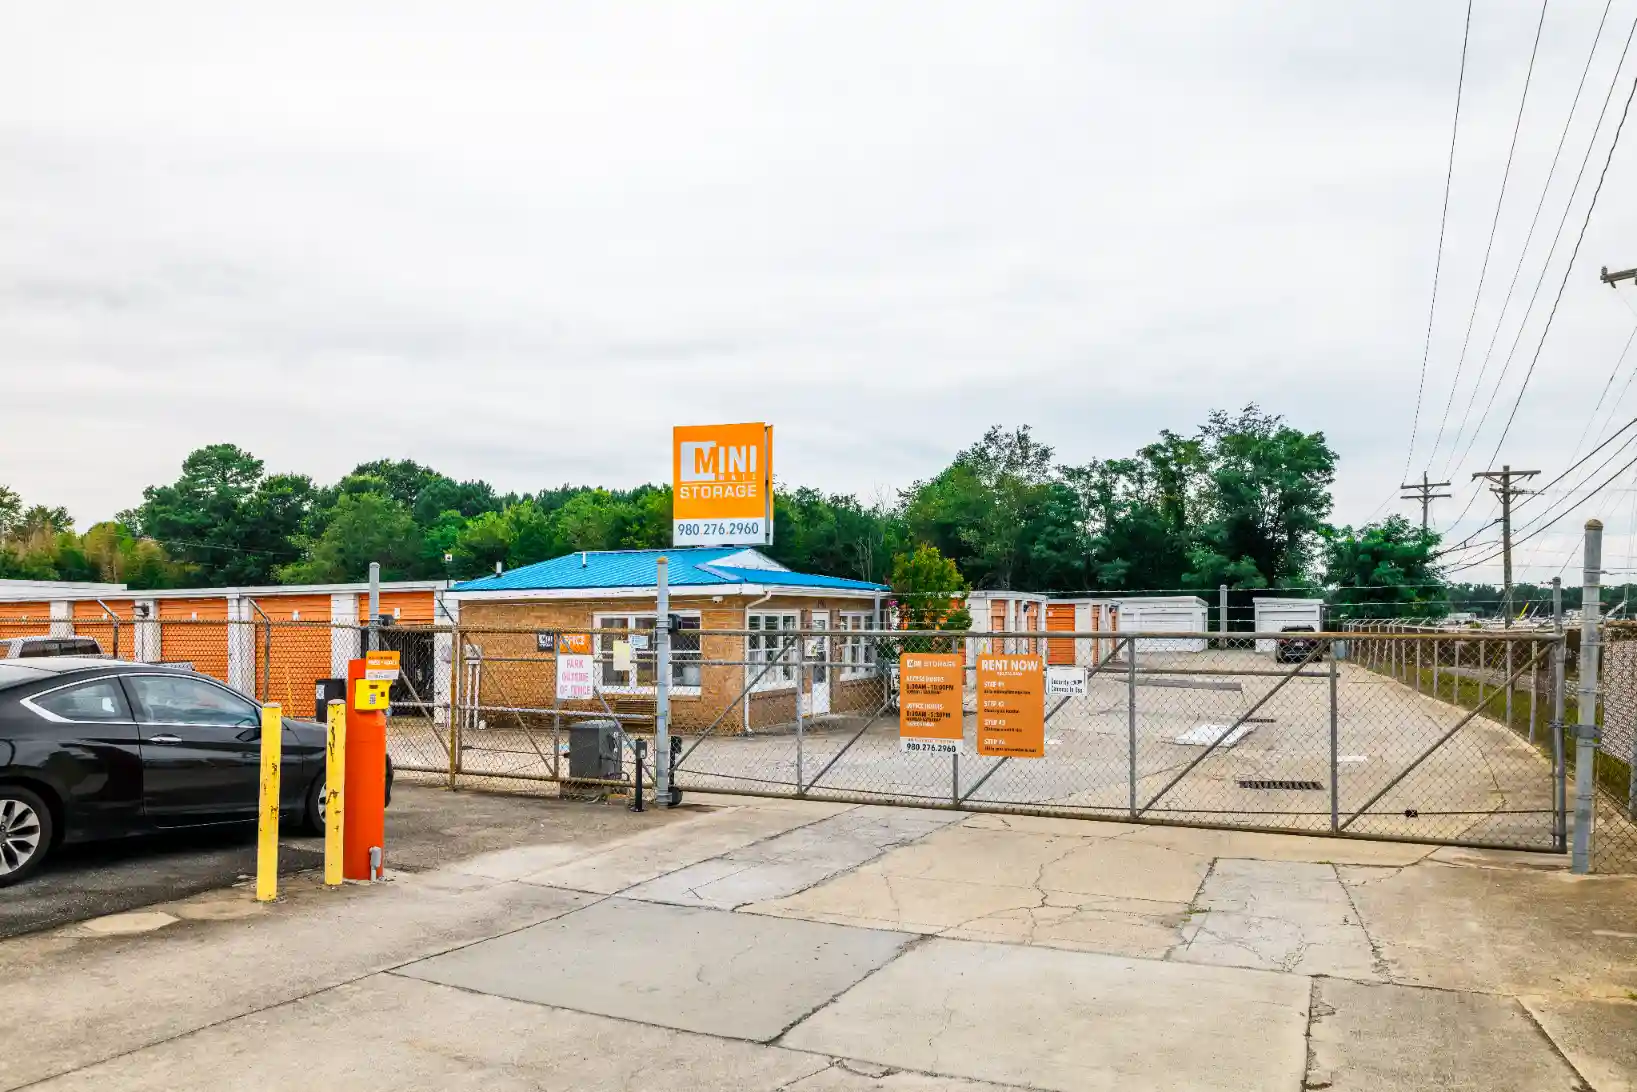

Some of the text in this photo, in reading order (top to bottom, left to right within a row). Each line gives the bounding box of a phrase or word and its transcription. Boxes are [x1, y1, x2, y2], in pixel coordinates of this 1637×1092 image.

[682, 442, 757, 479] MINI
[680, 485, 757, 499] STORAGE
[678, 522, 759, 536] 980.276.2960
[566, 659, 584, 668] PARK
[981, 659, 1038, 671] RENT NOW
[562, 672, 589, 682] OUTSIDE
[560, 686, 591, 696] OF FENCE
[906, 743, 956, 752] 980.276.2960
